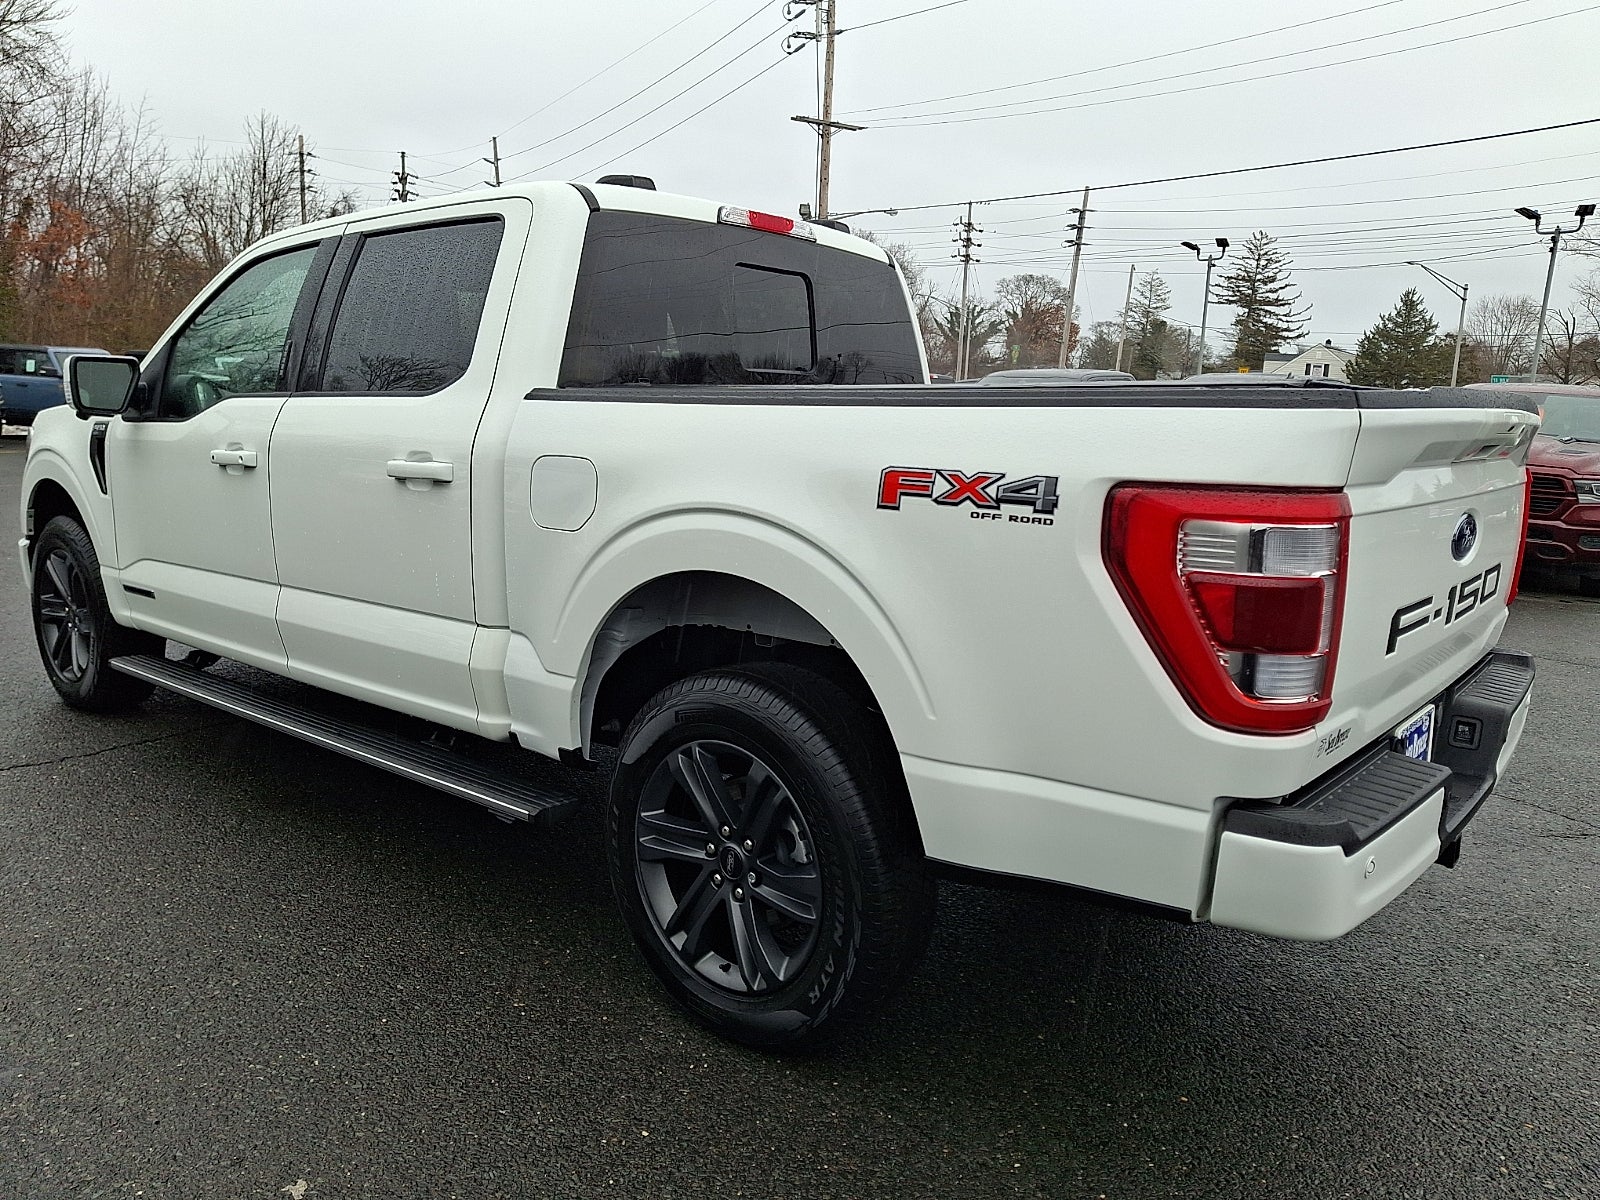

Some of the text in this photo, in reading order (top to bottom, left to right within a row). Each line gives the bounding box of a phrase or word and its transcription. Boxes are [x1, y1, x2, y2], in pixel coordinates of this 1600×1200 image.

[876, 465, 1060, 515] FX4
[970, 511, 1054, 526] OFF ROAD
[1385, 562, 1502, 657] F-150
